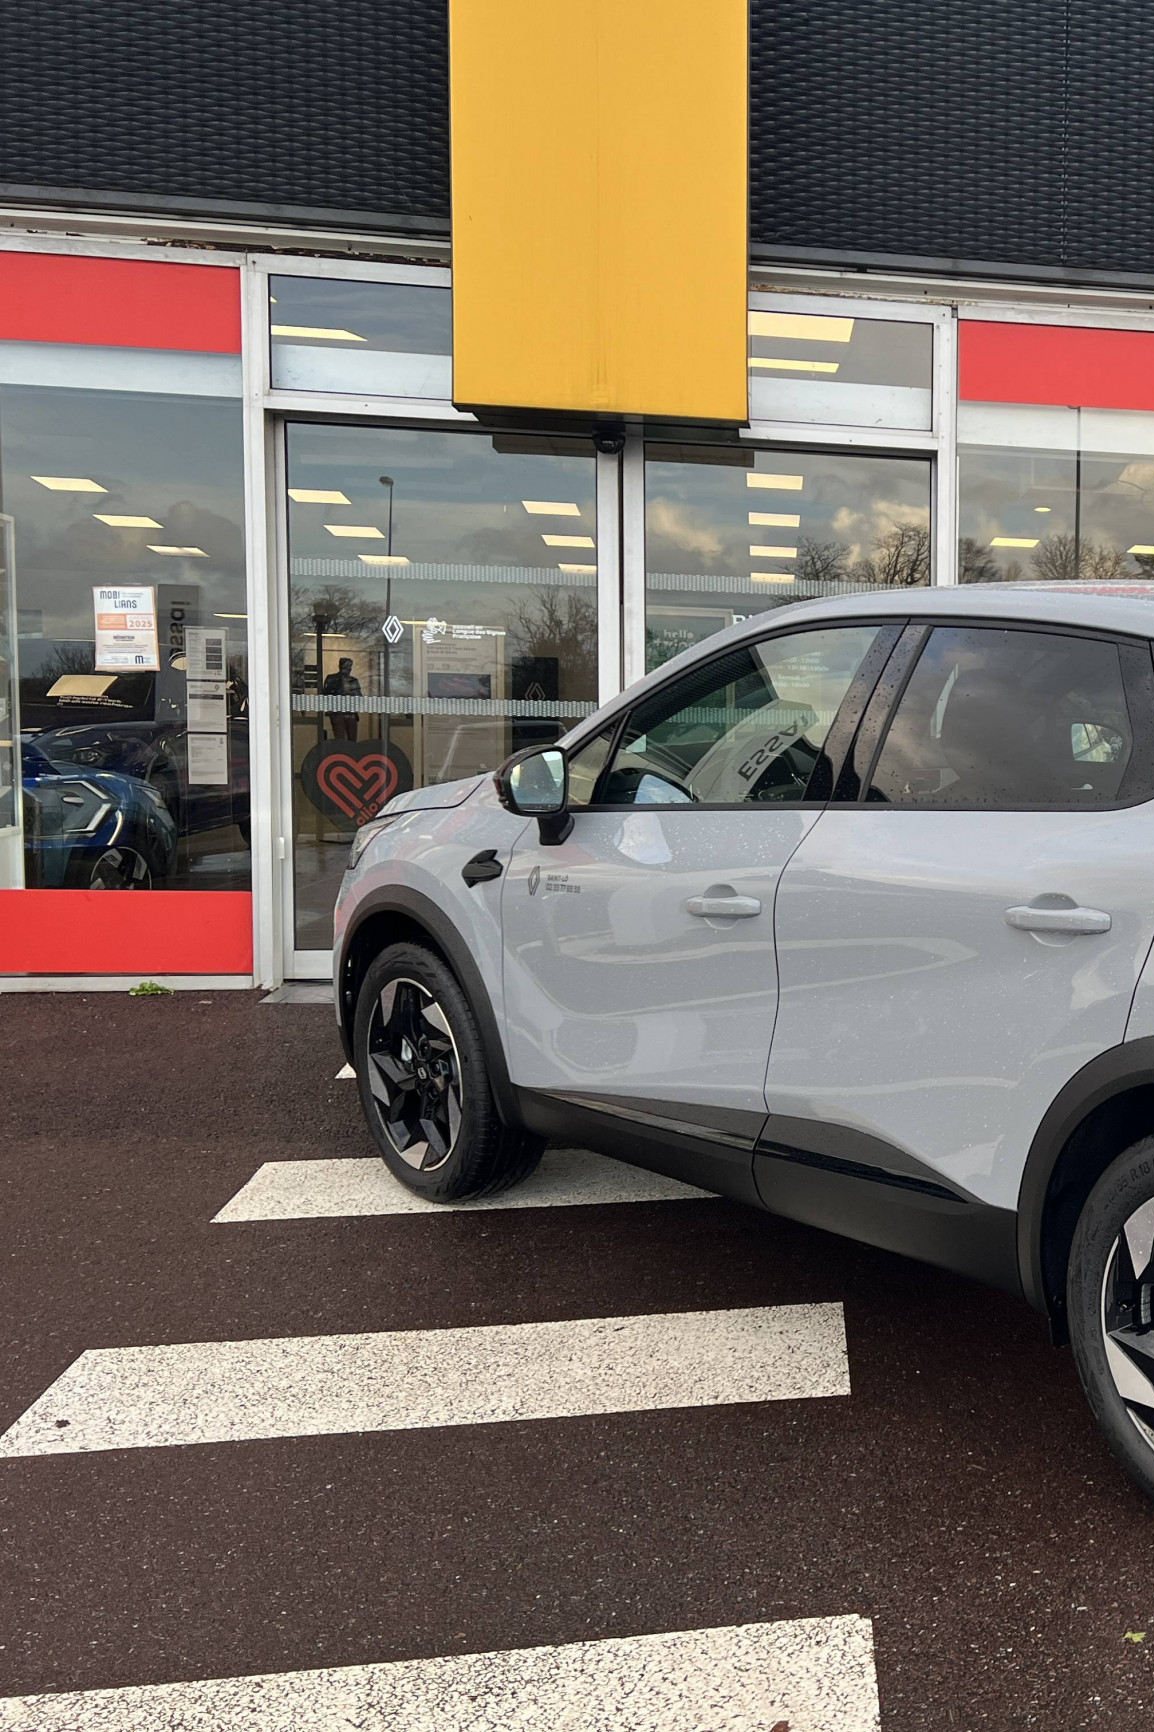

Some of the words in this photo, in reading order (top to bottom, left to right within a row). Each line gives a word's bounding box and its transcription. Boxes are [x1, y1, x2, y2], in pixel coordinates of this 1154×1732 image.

[99, 590, 120, 599] MOBI
[114, 600, 138, 609] LIANS
[129, 620, 153, 628] 2025
[663, 629, 694, 639] hello
